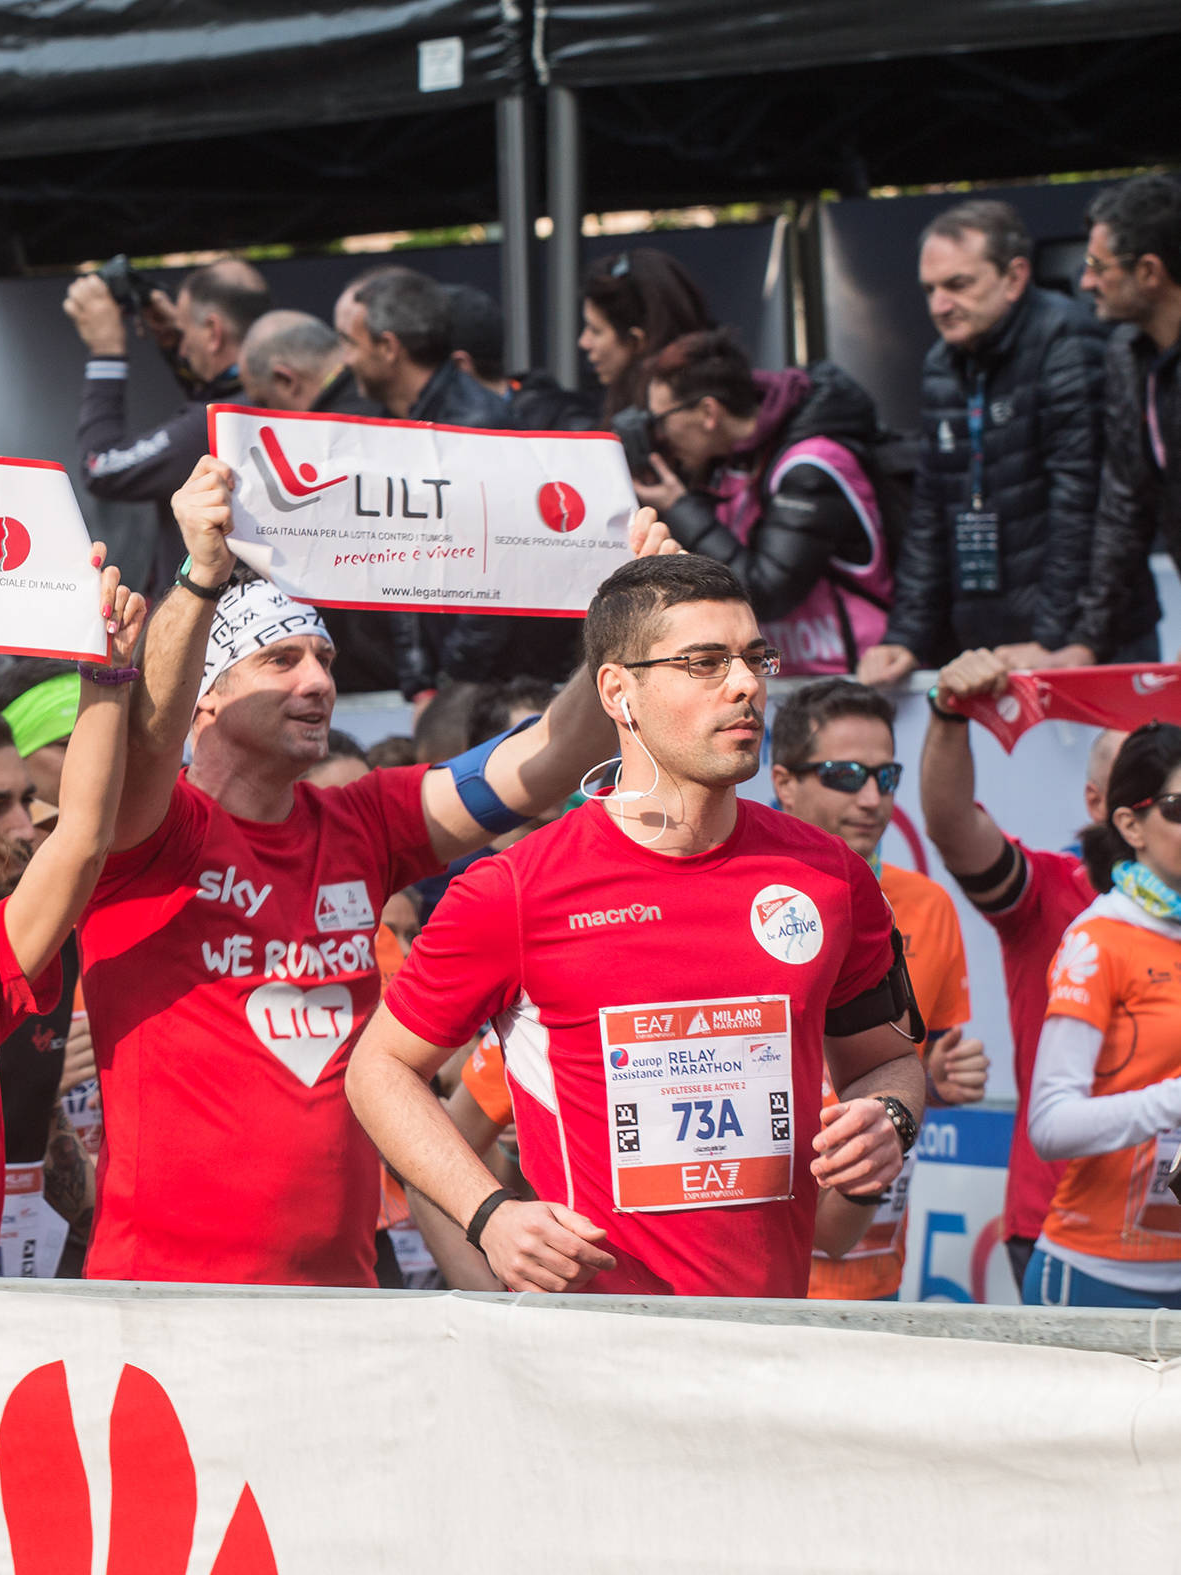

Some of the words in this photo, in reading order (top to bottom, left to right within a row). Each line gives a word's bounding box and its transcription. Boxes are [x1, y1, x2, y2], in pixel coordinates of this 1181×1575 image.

[356, 474, 451, 519] LILT
[255, 526, 278, 536] LEGA
[280, 528, 318, 538] ITALIANA
[320, 529, 337, 538] PER
[338, 530, 349, 539] LA
[350, 530, 376, 540] LOTTA
[420, 533, 453, 543] TUMORI
[334, 548, 407, 567] prevenire
[426, 545, 476, 559] vivere
[28, 580, 38, 589] DI
[40, 581, 77, 592] MILANO
[381, 586, 501, 600] www.legatumori.mi.it
[196, 865, 272, 918] sky
[569, 903, 663, 930] macron
[201, 934, 253, 977] WE
[264, 940, 325, 980] RUN
[320, 934, 375, 976] FOR
[264, 1005, 344, 1040] LILT
[633, 1013, 674, 1035] EA7
[712, 1008, 762, 1023] MILANO
[712, 1020, 762, 1030] MARATHON
[632, 1056, 663, 1068] europ
[668, 1048, 716, 1064] RELAY
[612, 1069, 664, 1082] assistance
[670, 1061, 742, 1077] MARATHON
[660, 1084, 701, 1096] SVELTESSE
[703, 1083, 713, 1092] BE
[714, 1082, 739, 1091] ACTIVE
[740, 1081, 746, 1090] 2
[671, 1098, 745, 1142] 73A
[681, 1161, 741, 1192] EA7
